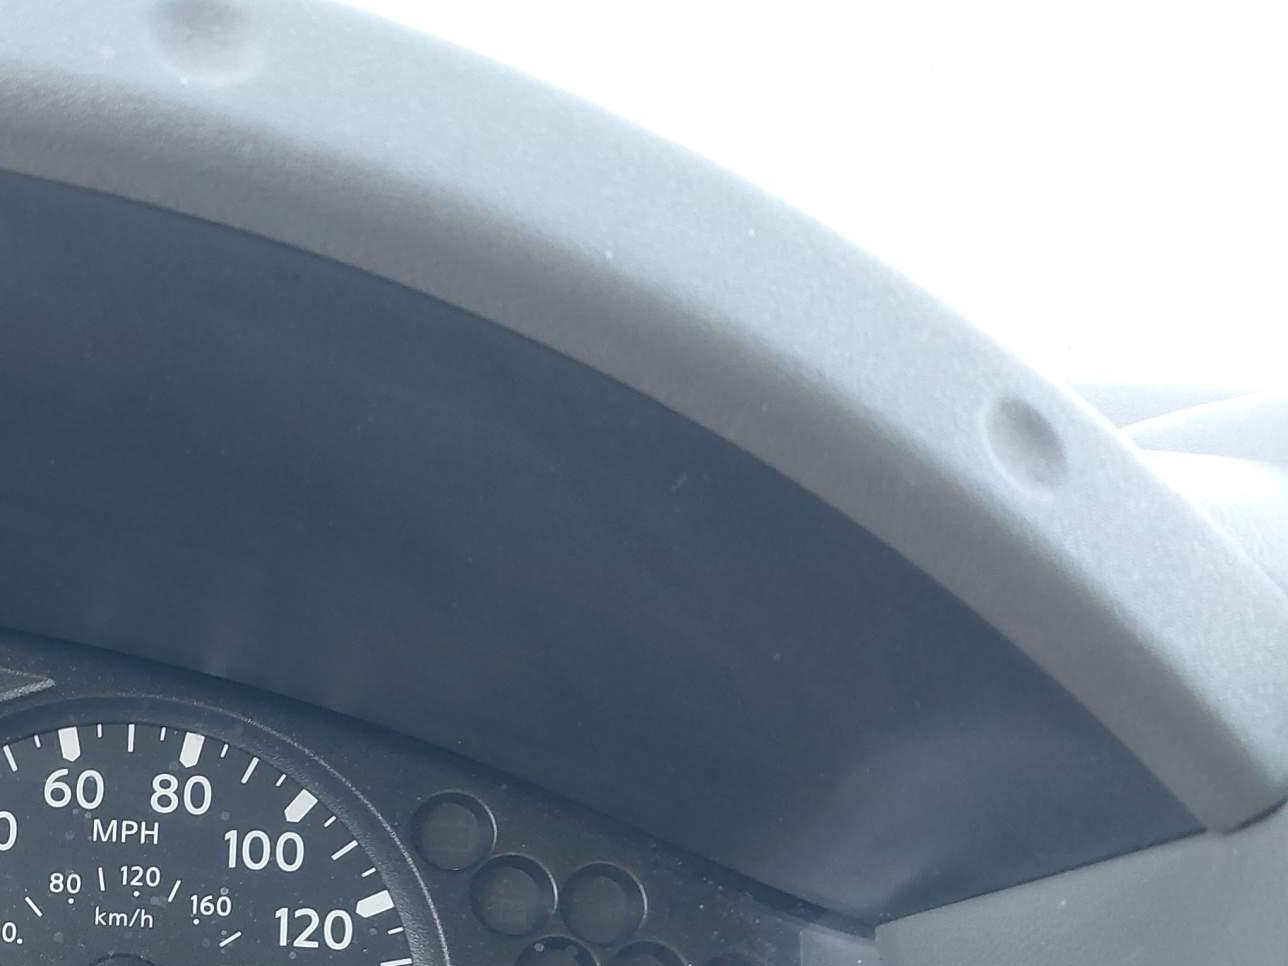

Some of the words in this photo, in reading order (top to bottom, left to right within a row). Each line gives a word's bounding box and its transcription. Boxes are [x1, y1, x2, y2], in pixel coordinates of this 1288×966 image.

[43, 769, 105, 810] 60
[150, 773, 212, 815] 80
[92, 819, 160, 845] MPH
[225, 830, 304, 872] 100
[49, 872, 82, 895] 80
[120, 865, 162, 888] 120
[94, 905, 154, 930] km/h
[190, 895, 232, 918] 160
[274, 907, 353, 950] 120
